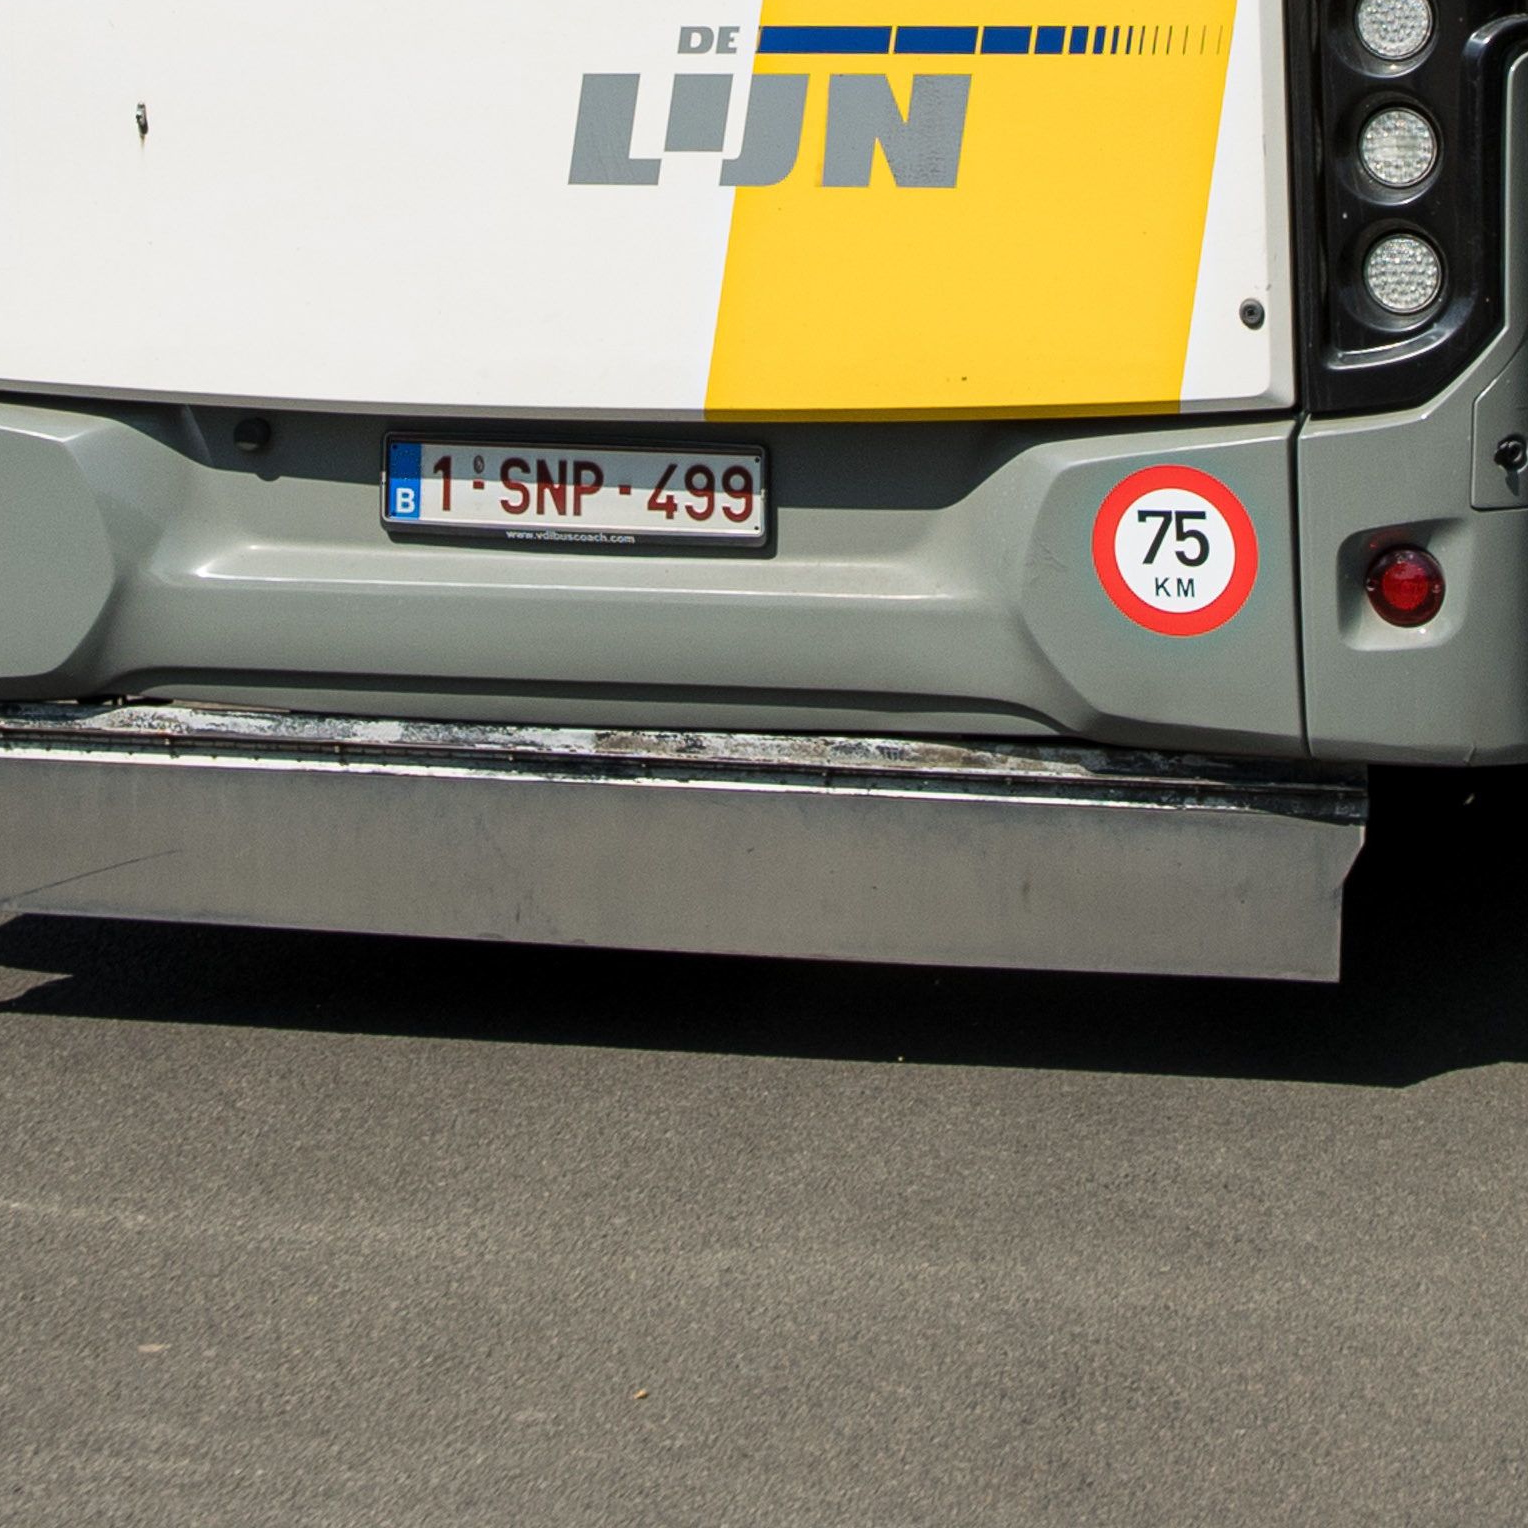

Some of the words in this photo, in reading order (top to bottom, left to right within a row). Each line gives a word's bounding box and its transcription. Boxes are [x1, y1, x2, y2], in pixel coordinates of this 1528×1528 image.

[677, 25, 740, 54] DE
[568, 73, 972, 188] LIJN
[395, 487, 416, 514] B
[1137, 509, 1210, 568] 75
[1155, 576, 1195, 598] KM
